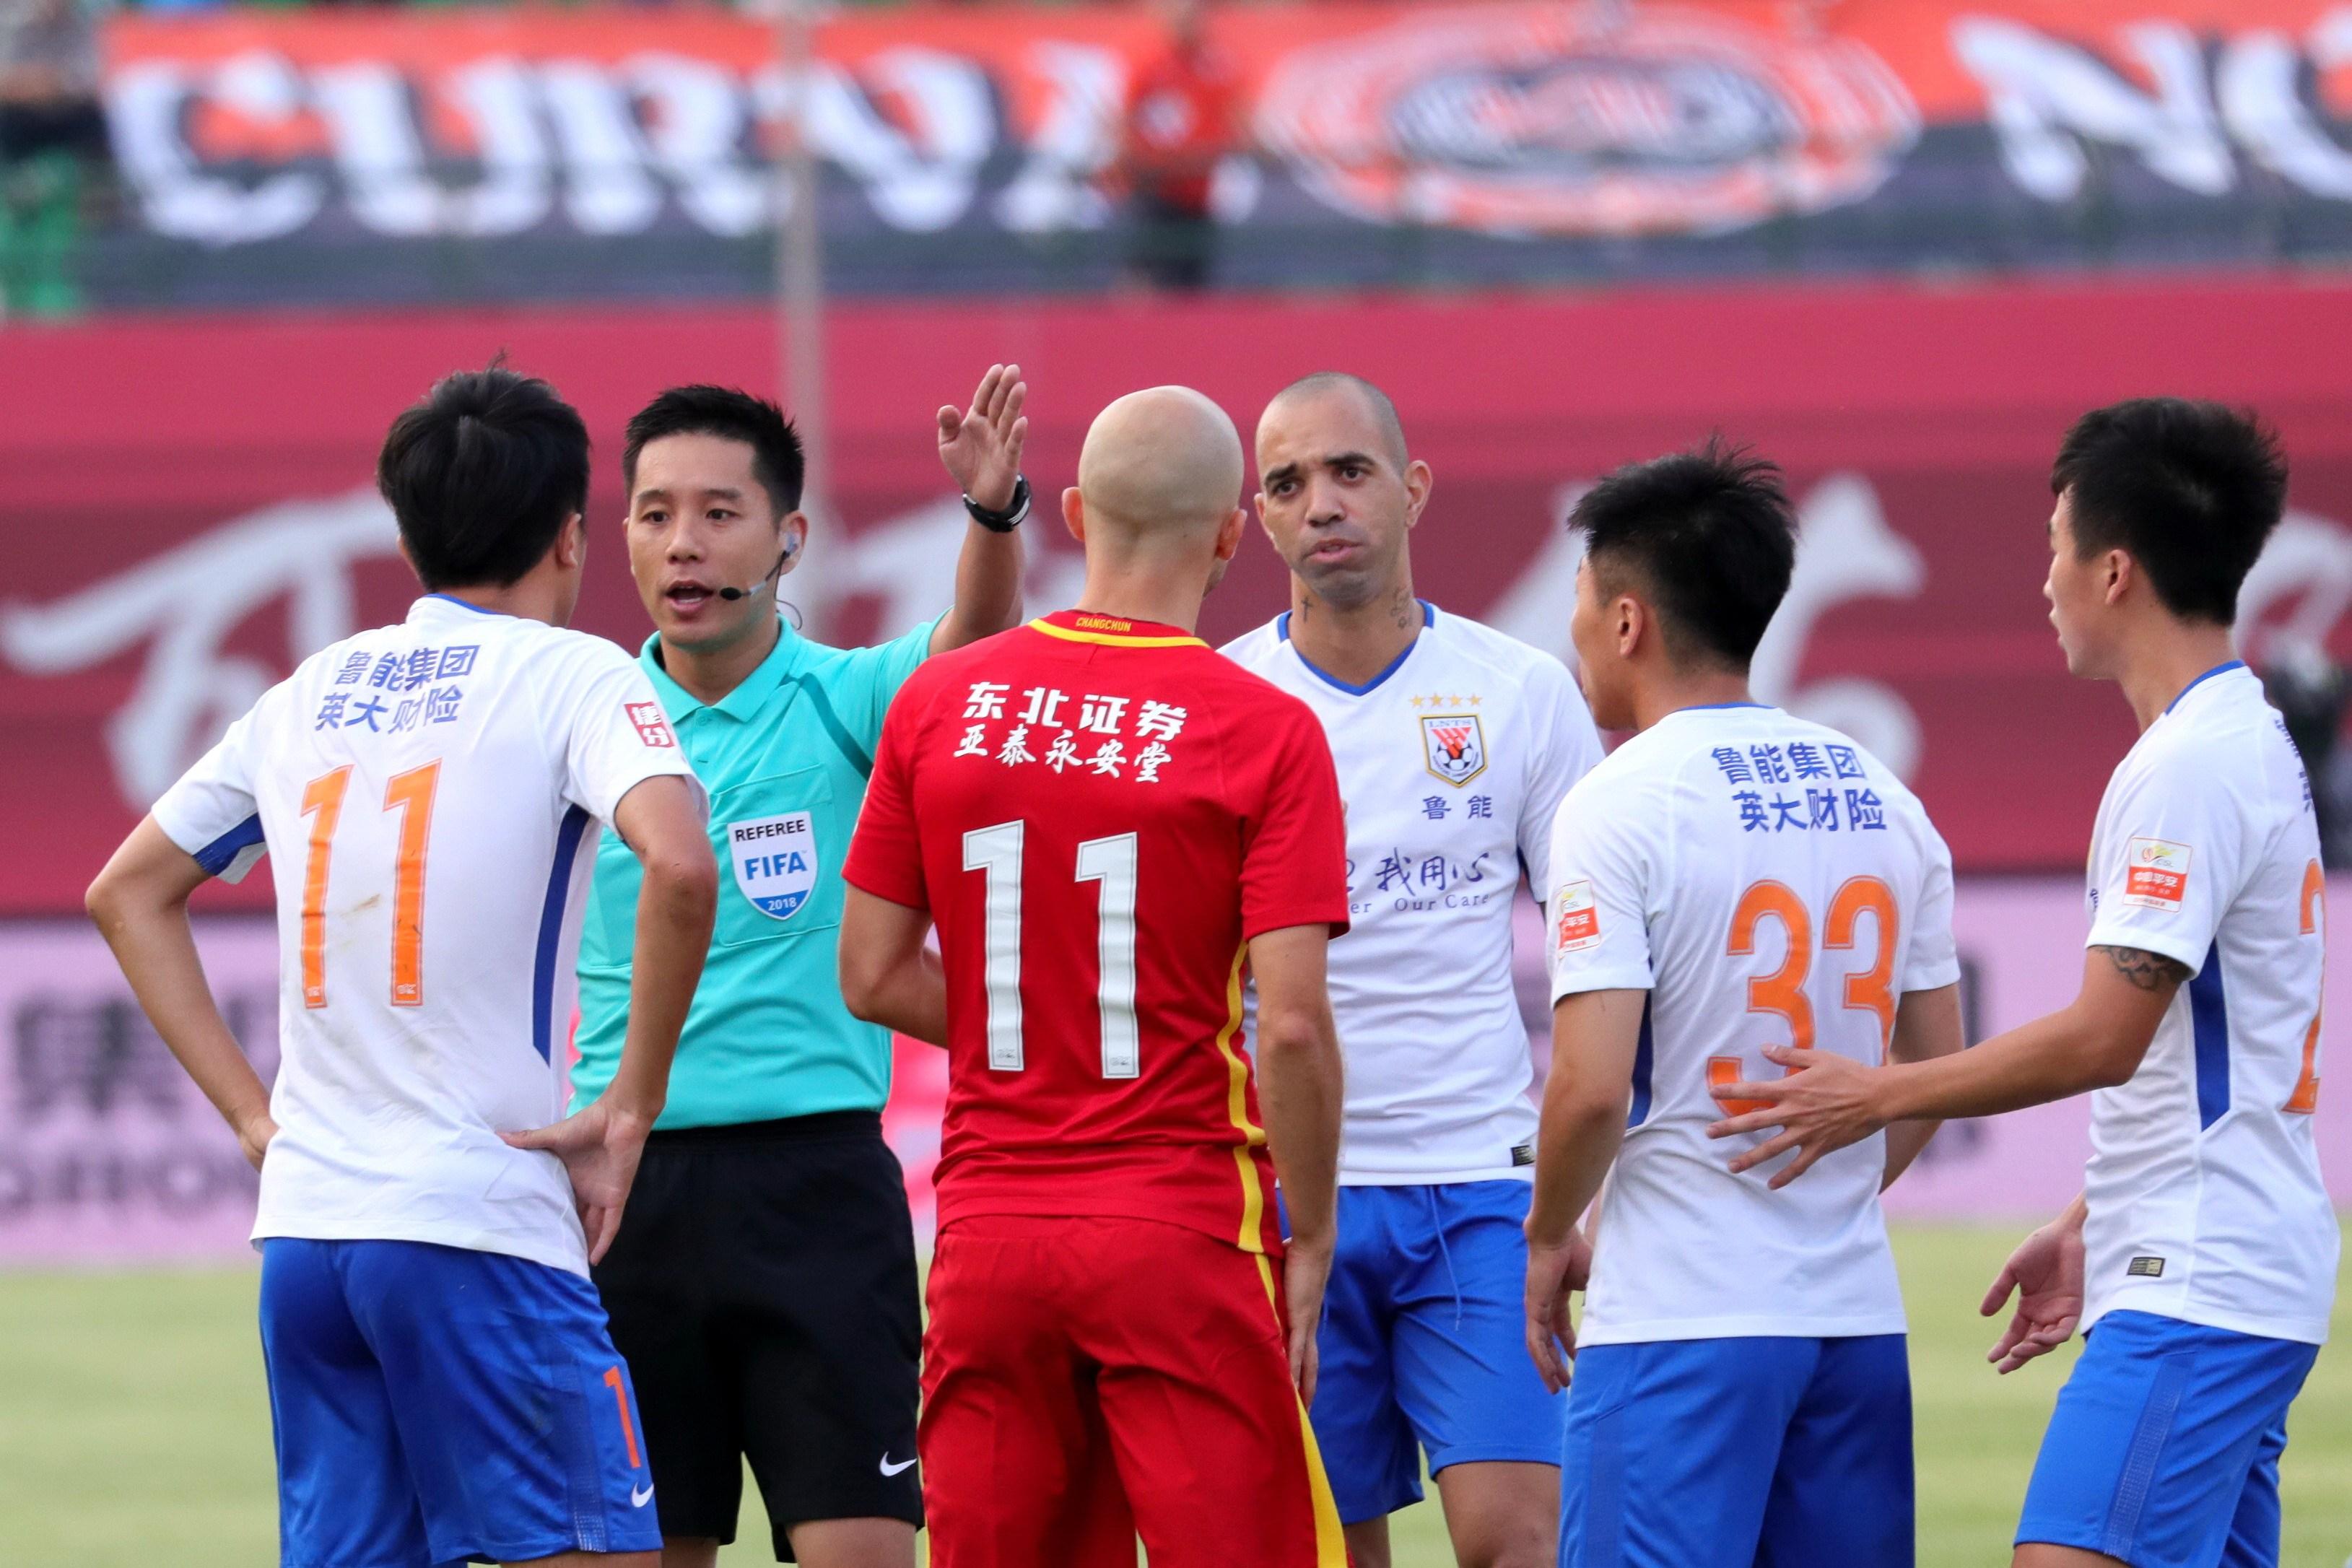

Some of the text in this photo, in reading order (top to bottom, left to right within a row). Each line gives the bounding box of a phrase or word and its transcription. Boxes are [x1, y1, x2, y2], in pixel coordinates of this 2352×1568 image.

[1076, 617, 1132, 632] CHANGCHUN
[335, 645, 481, 692] 鲁能集团
[315, 685, 463, 735] 英大财险
[962, 681, 1188, 741] 东北证券
[954, 723, 1172, 783] 亚泰永安堂
[1711, 742, 1865, 785] 鲁能集团
[1422, 796, 1493, 820] 鲁能
[1732, 788, 1886, 832] 英大财险
[735, 819, 806, 842] REFEREE
[300, 757, 443, 1009] 11
[744, 851, 808, 880] FIFA
[767, 897, 797, 912] 2018
[1395, 897, 1436, 911] Our
[1445, 894, 1490, 908] Care
[962, 819, 1140, 1079] 11
[1706, 875, 1899, 1120] 33
